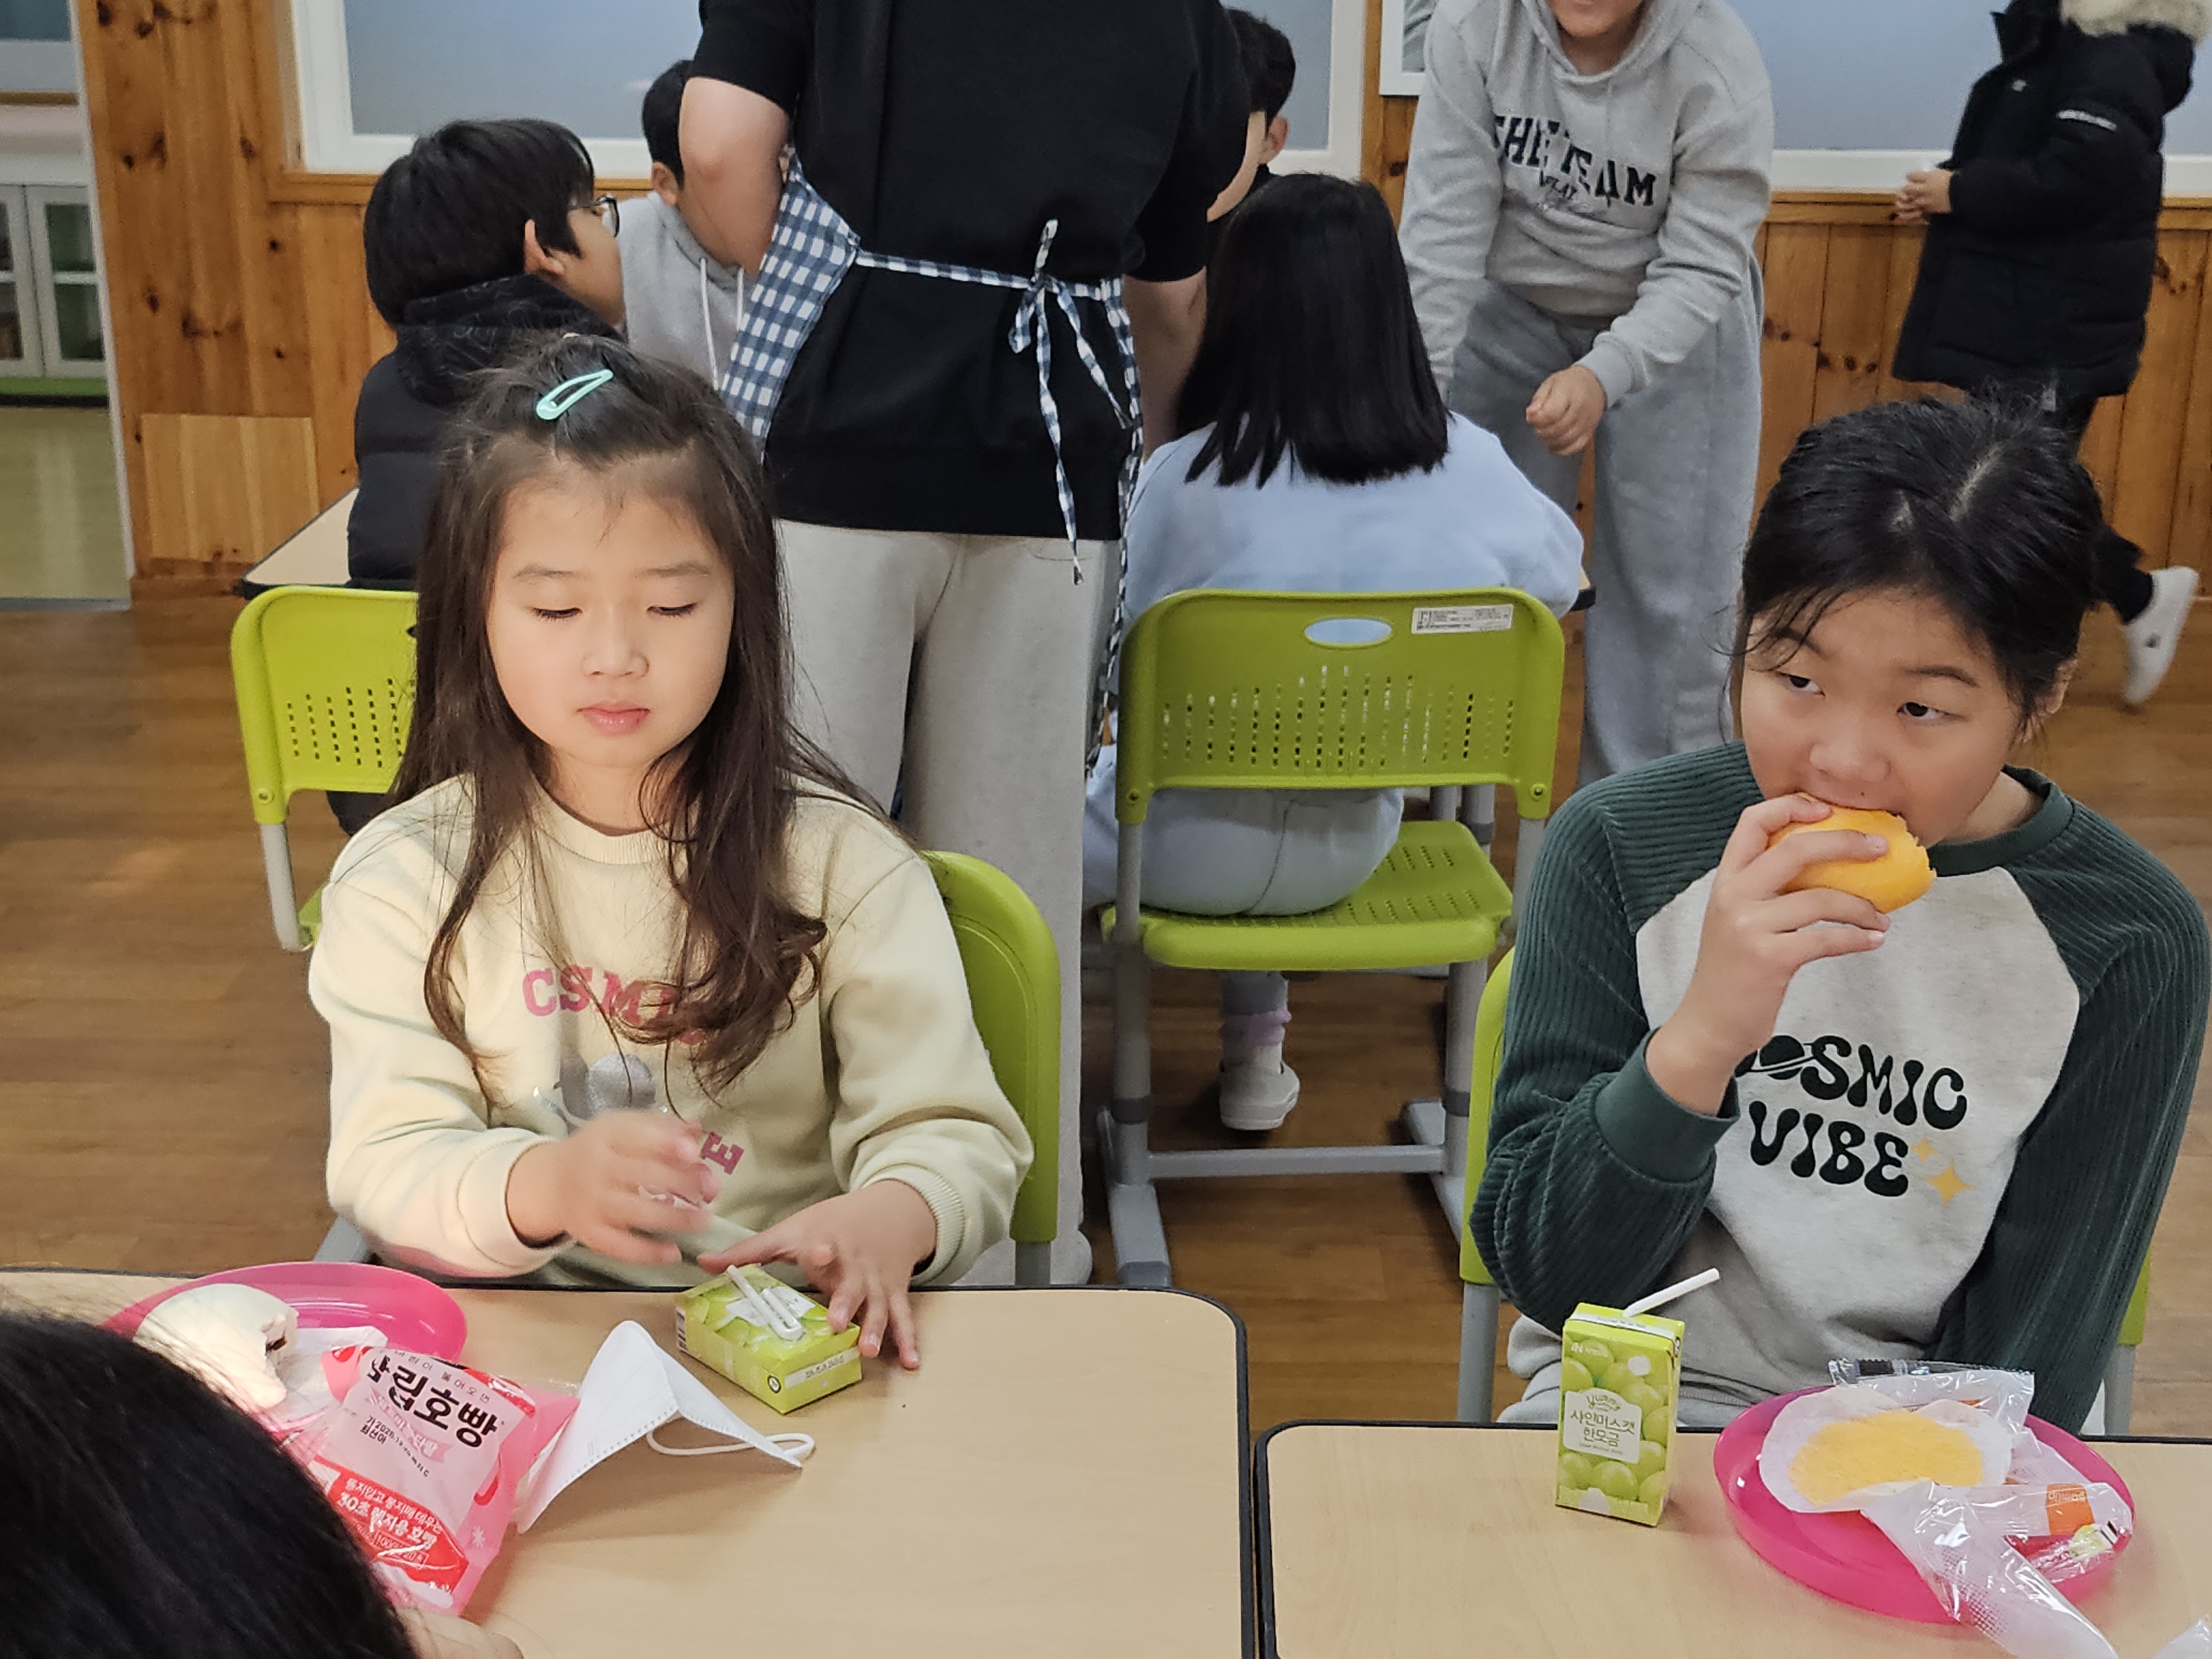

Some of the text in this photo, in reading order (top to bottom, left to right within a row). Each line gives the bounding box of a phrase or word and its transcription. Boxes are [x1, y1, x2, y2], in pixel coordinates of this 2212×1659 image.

[1734, 1035, 1968, 1130] OSMIC
[1748, 1100, 1909, 1197] VIBE
[336, 1492, 369, 1517] 30초
